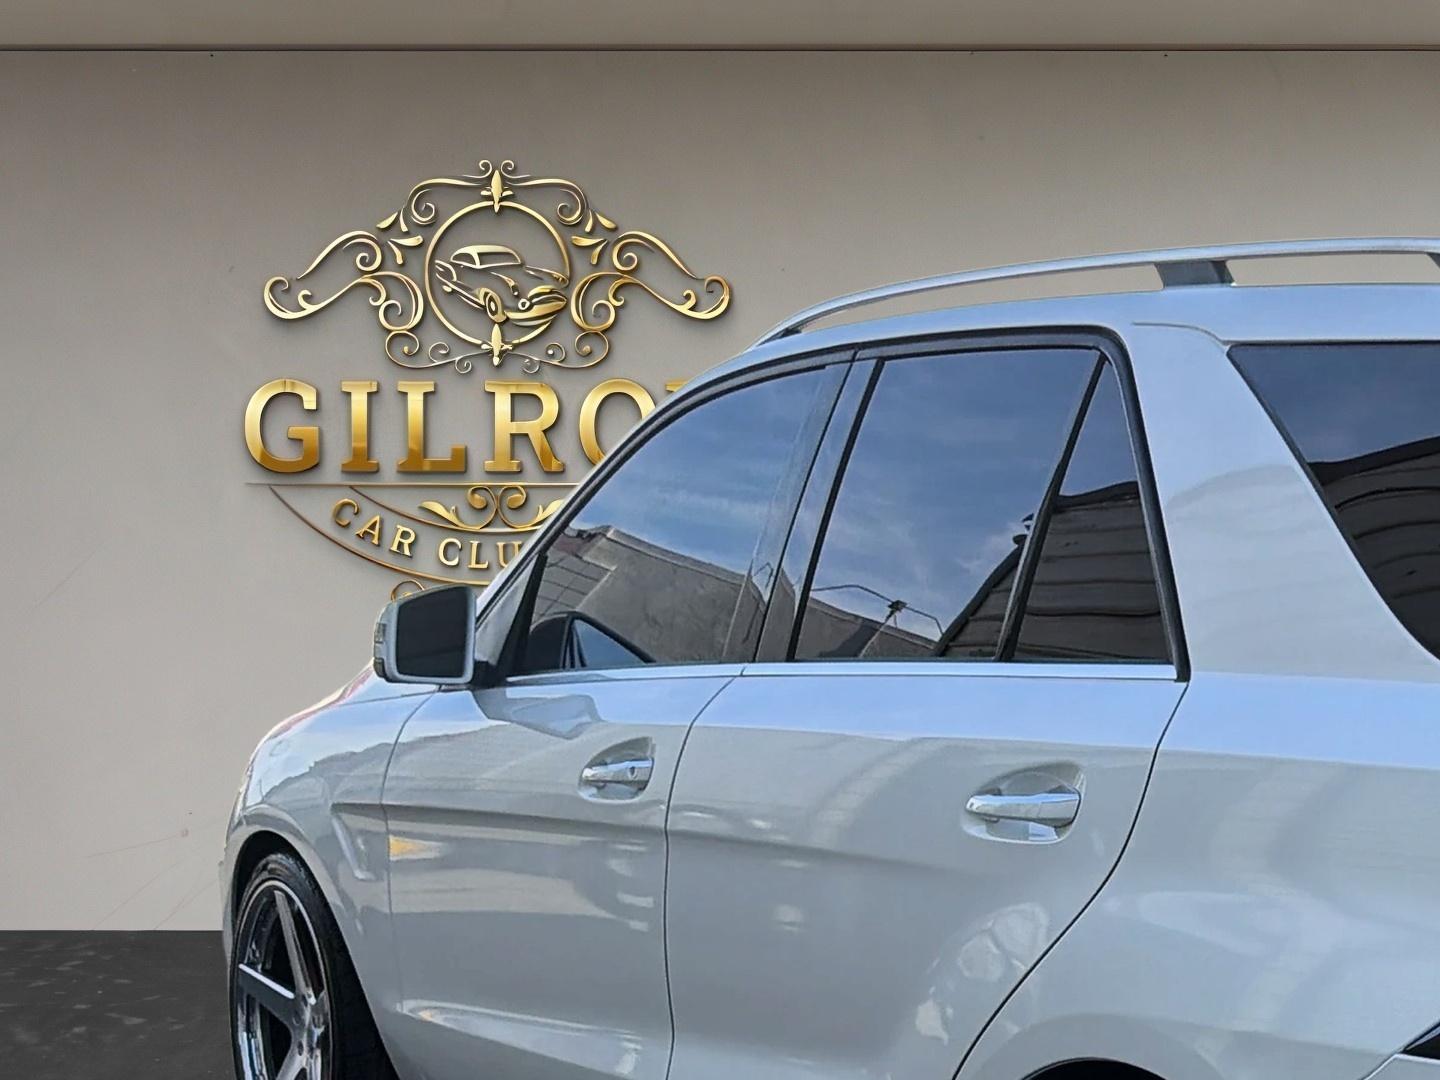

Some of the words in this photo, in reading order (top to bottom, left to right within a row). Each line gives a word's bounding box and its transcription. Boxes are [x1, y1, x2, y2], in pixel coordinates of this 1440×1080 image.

[244, 378, 690, 472] GILRO
[331, 498, 417, 558] CAR
[437, 537, 521, 570] CLU
